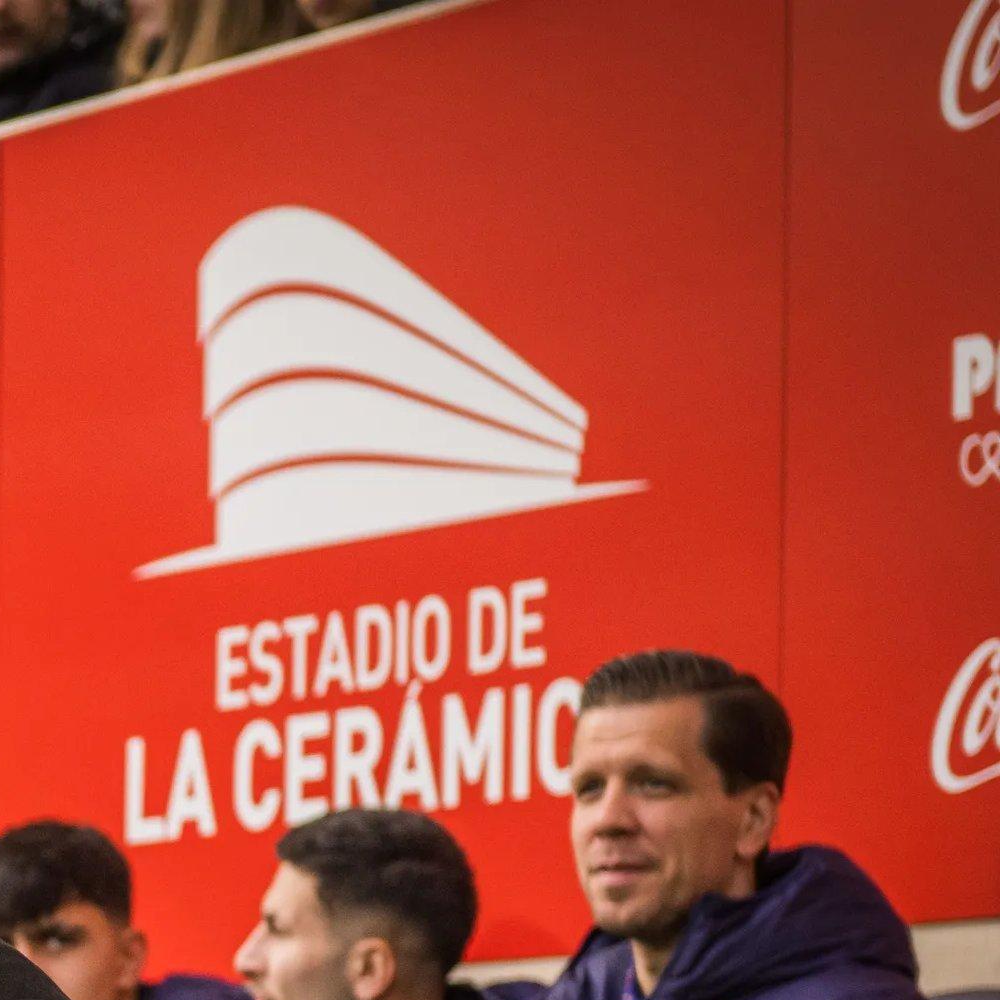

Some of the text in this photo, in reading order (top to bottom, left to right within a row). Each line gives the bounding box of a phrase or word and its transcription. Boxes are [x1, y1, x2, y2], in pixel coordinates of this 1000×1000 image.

[215, 577, 547, 711] ESTADIO DE
[123, 679, 586, 846] LA CERÁMIC
